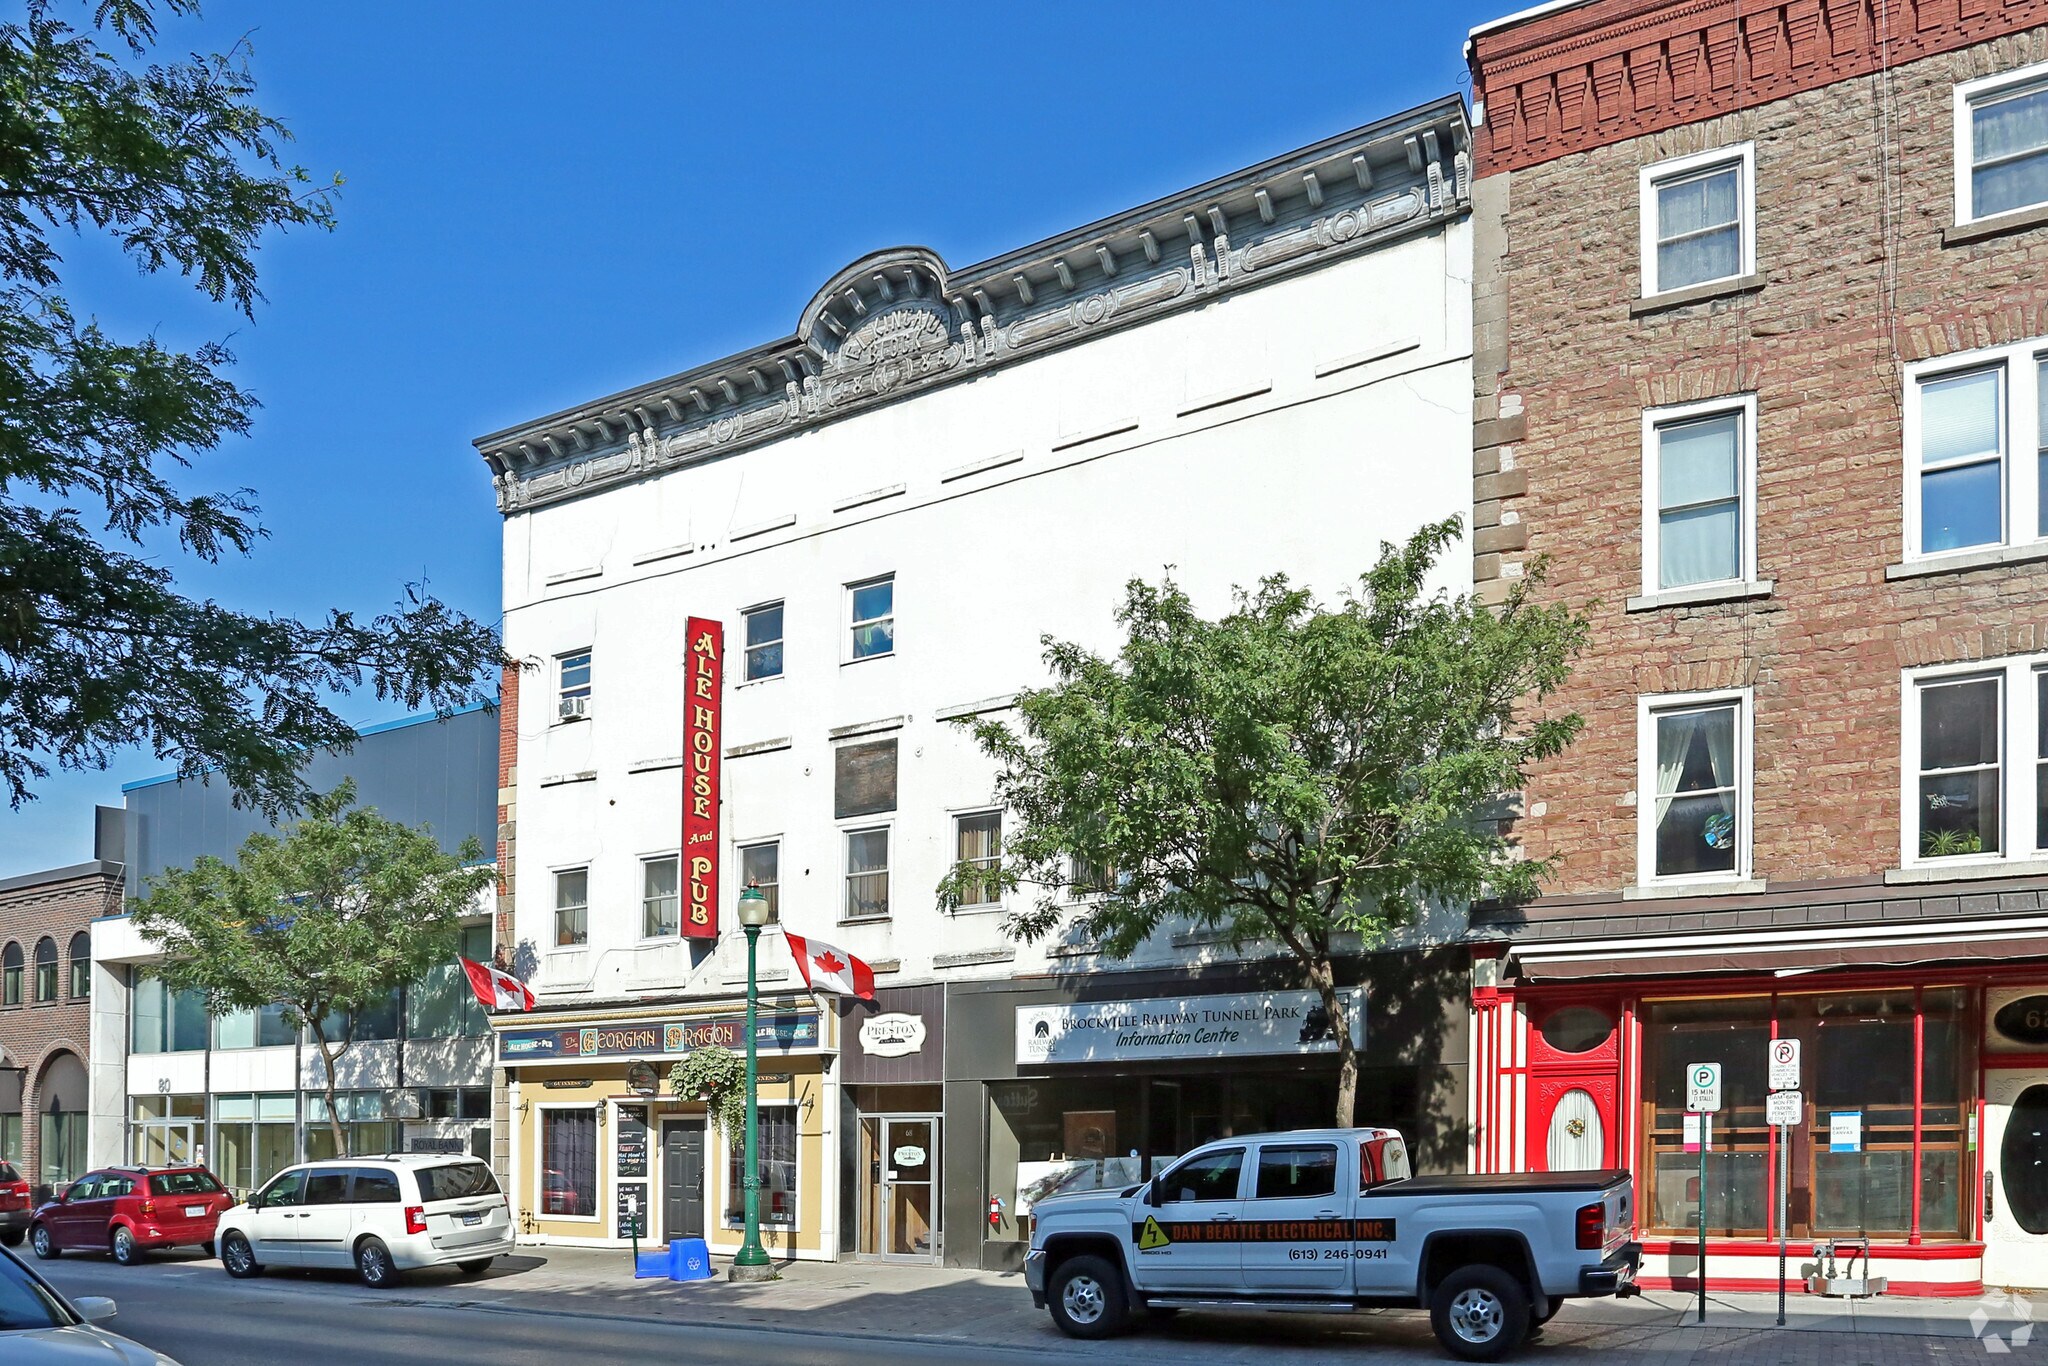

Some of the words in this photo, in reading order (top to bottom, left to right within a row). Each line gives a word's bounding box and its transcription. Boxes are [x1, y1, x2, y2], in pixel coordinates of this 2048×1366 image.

[693, 631, 717, 700] ALE
[693, 704, 715, 820] HOUSE
[688, 830, 713, 845] And
[690, 856, 713, 925] PUB
[1062, 1015, 1137, 1030] BROCKVILLE
[1142, 1012, 1198, 1026] RAILWAY
[1202, 1009, 1260, 1022] TUNNEL
[1265, 1005, 1300, 1020] PARK
[756, 1029, 766, 1037] LE
[766, 1027, 788, 1037] HOUSE
[867, 1023, 917, 1036] PRESTON
[1115, 1029, 1191, 1047] Information
[1194, 1026, 1239, 1043] Centre
[510, 1043, 521, 1051] ALE
[521, 1040, 538, 1050] HOUSE
[542, 1039, 553, 1048] PUB
[583, 1031, 655, 1053] GEORGIAN
[667, 1026, 733, 1047] DRAGON
[1028, 1036, 1057, 1046] RAILWAY
[1029, 1044, 1057, 1053] TUNNEL
[158, 1078, 171, 1093] 80
[414, 1140, 436, 1150] ROYAL
[439, 1140, 461, 1150] BANK
[1173, 1224, 1200, 1240] DAN
[1206, 1223, 1261, 1240] BEATTIE
[1267, 1221, 1351, 1239] ELECTRICAL
[1288, 1248, 1318, 1261] (613)
[1324, 1248, 1387, 1260] 246-0941
